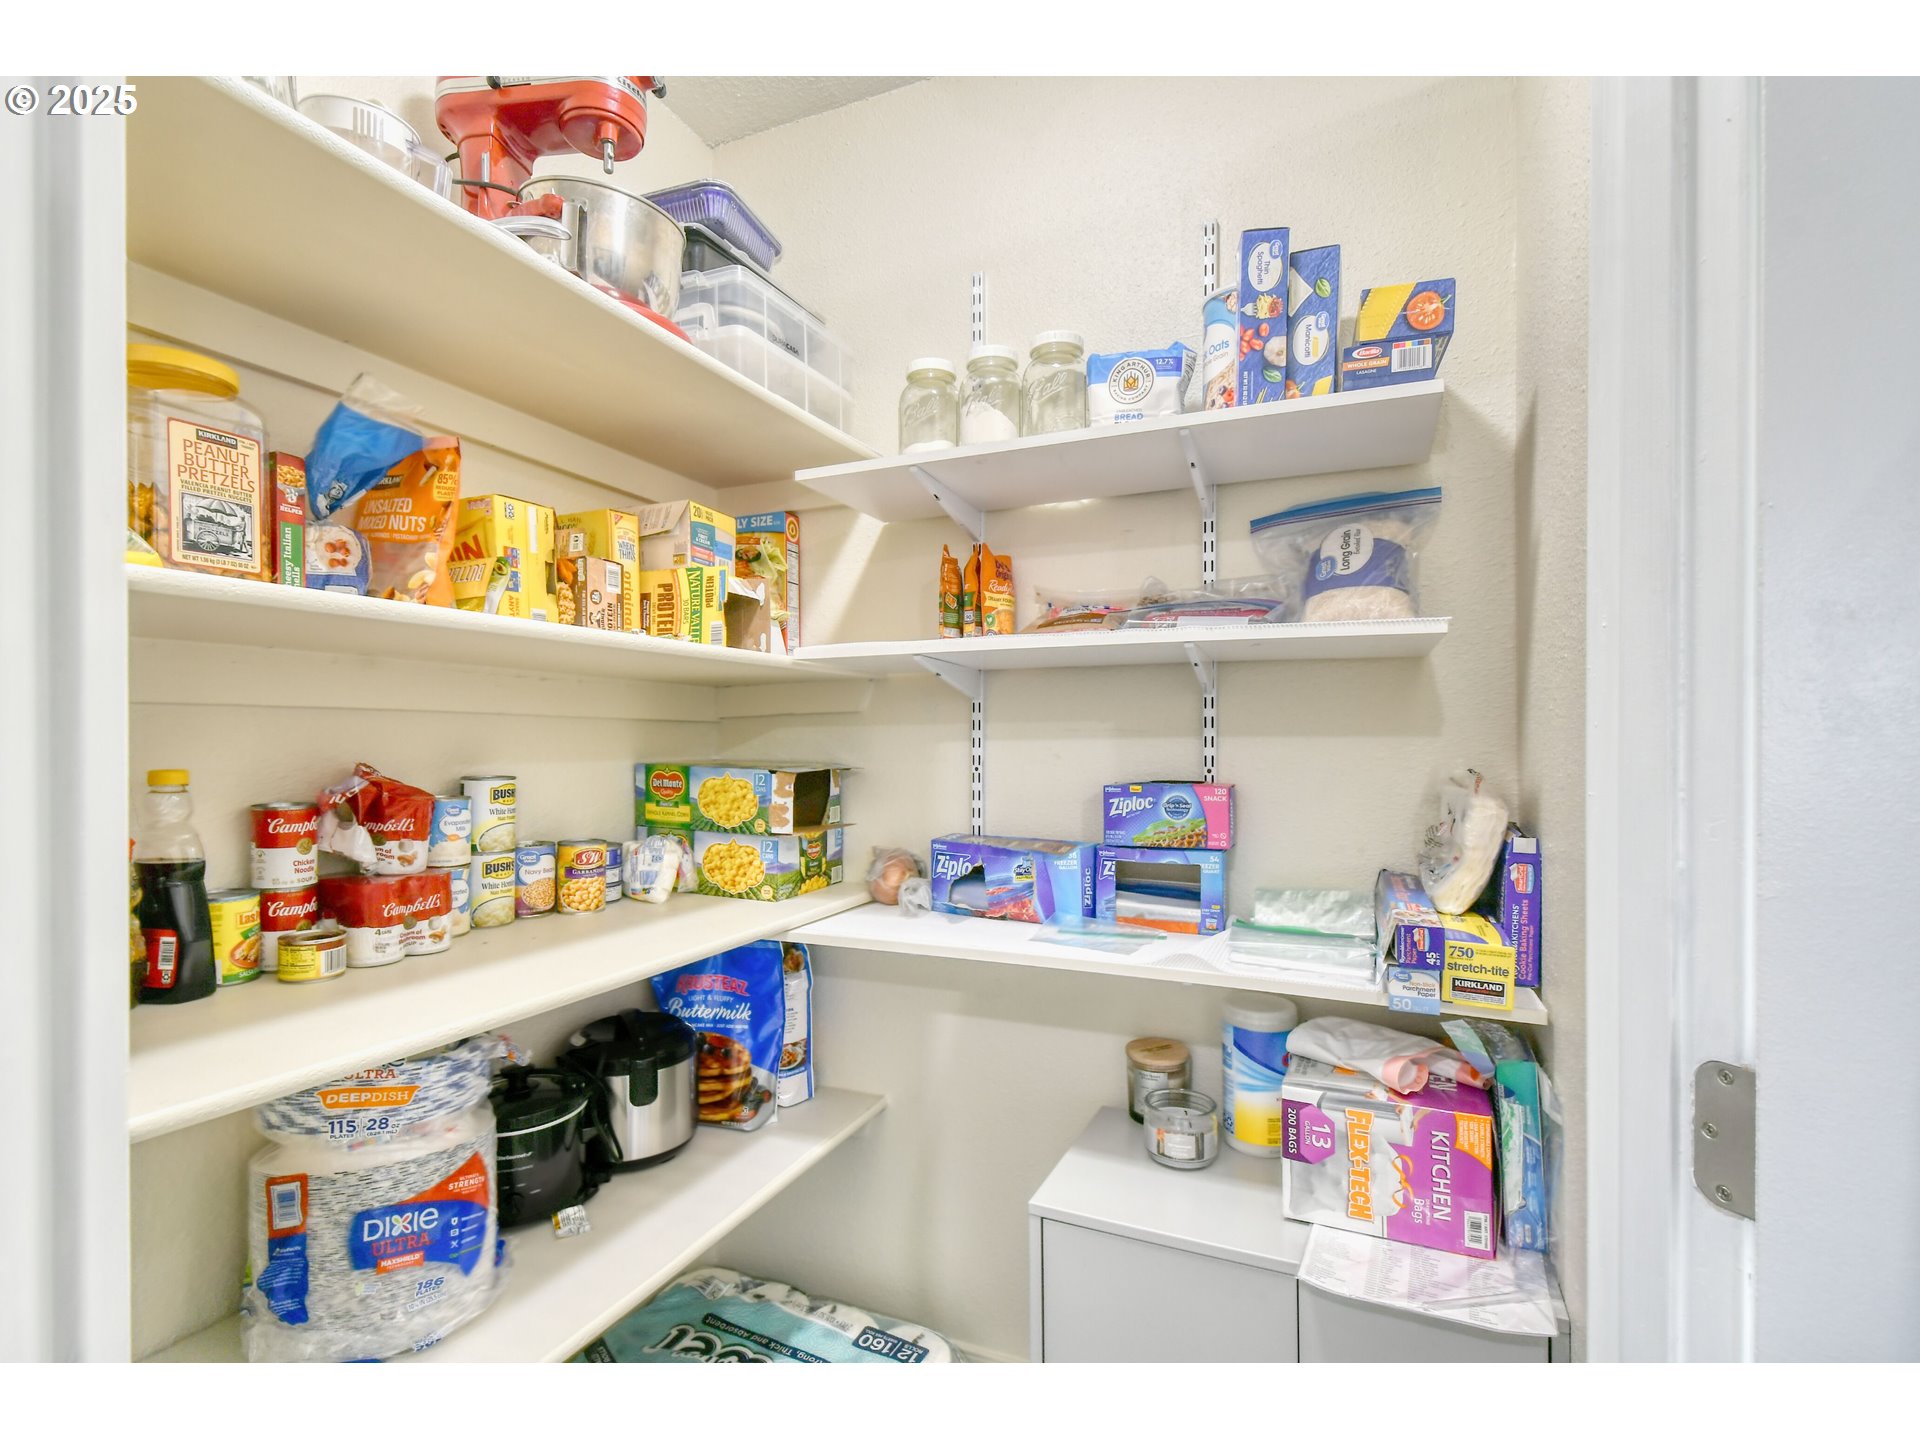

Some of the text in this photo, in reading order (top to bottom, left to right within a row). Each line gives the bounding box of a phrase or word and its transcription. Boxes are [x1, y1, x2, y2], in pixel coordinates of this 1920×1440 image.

[1256, 252, 1264, 285] Spaghetti
[1209, 340, 1230, 355] Oats
[1304, 324, 1312, 358] Manicotti
[1113, 361, 1150, 382] KING ARTHUR
[1114, 413, 1144, 421] BREAD
[198, 430, 236, 445] KIRKLAND
[184, 438, 249, 466] PEANUT
[184, 452, 249, 479] BUTTER
[178, 464, 255, 493] PRETZELS
[180, 479, 208, 488] VALENCIA
[210, 484, 231, 492] PEANUT
[203, 488, 226, 498] PRETZEL
[228, 494, 252, 503] NUGGETS
[280, 505, 303, 515] HELPER
[364, 498, 412, 515] UNSALTED
[359, 515, 426, 532] MIXED NUTS
[737, 516, 774, 528] LY SIZE
[617, 541, 635, 550] WHEAT
[1340, 529, 1352, 571] Long Grain
[619, 549, 635, 562] THINS
[284, 560, 293, 586] heesy
[705, 576, 714, 608] PROTEIN
[687, 571, 701, 644] NATURE VALLE
[652, 778, 682, 788] Del Monte
[755, 774, 766, 785] 12
[493, 788, 516, 800] BUSH
[1109, 796, 1153, 816] Ziploc
[364, 818, 414, 832] mpbell's
[762, 841, 773, 853] 12
[936, 854, 972, 880] Ziplo
[1103, 860, 1116, 875] Zi
[482, 882, 500, 890] White
[382, 894, 441, 918] Campbell's
[1520, 926, 1529, 952] Baking
[1426, 952, 1436, 965] 45
[1448, 946, 1475, 959] 750
[1447, 961, 1509, 977] stretch-tite
[1519, 954, 1527, 980] Cookie
[675, 974, 750, 996] KRUSTEAZ
[1454, 979, 1503, 992] KIRKLAND
[669, 996, 752, 1020] Buttermilk
[1392, 999, 1412, 1010] 50
[326, 1090, 409, 1104] DEEPDISH
[328, 1120, 357, 1134] 115
[366, 1117, 389, 1131] 28
[1287, 1108, 1297, 1154] 200 BAGS
[1311, 1124, 1331, 1149] 13
[1345, 1108, 1374, 1224] FLEX-TECH
[1431, 1130, 1452, 1221] KITCHEN
[1411, 1198, 1425, 1224] Bags
[371, 1233, 430, 1256] ULTRA
[380, 1253, 420, 1268] MAXSHIELD
[417, 1277, 445, 1290] 186
[705, 1316, 752, 1338] Absorbent
[751, 1334, 769, 1344] and
[769, 1341, 792, 1355] Thick
[858, 1334, 919, 1363] 12 160
[904, 1344, 924, 1354] ROLLS
